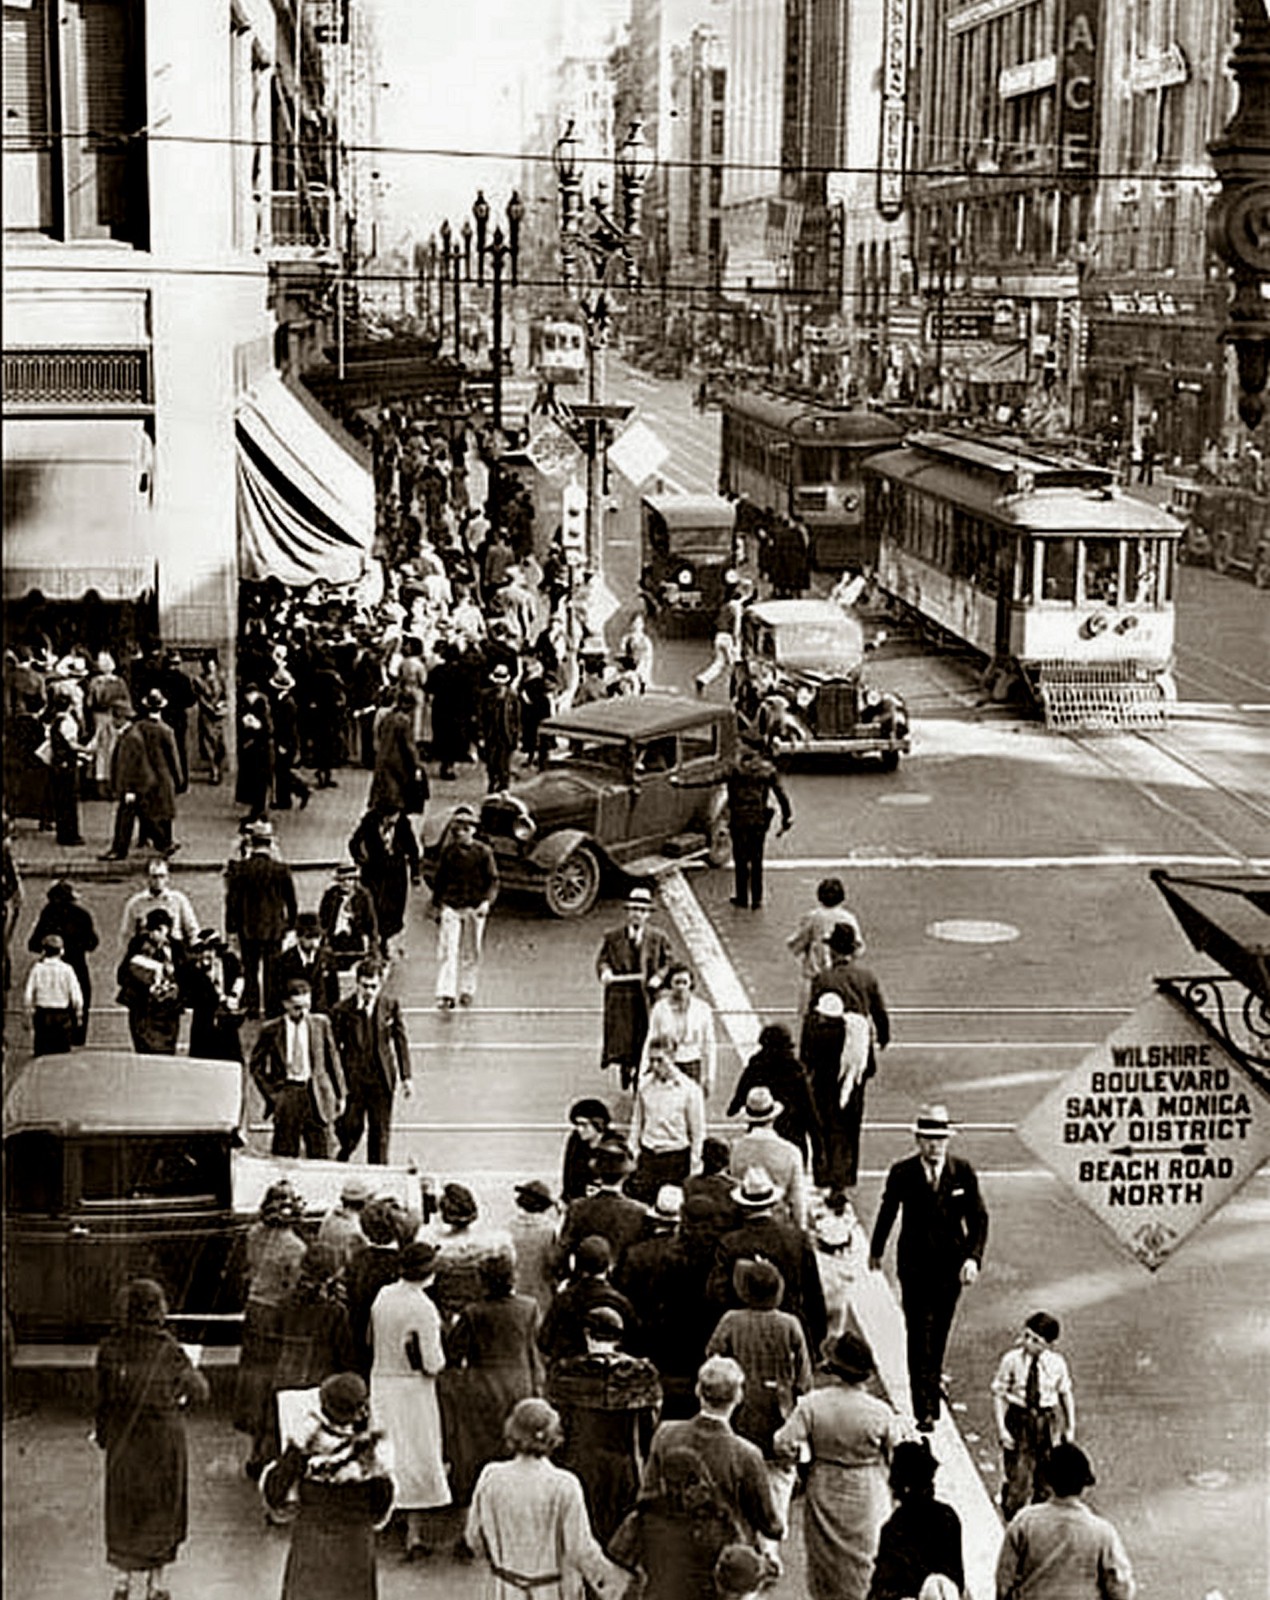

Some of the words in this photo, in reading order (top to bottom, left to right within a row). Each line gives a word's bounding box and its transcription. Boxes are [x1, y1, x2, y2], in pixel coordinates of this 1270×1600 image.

[1112, 1046, 1211, 1067] WILSHIRE
[1092, 1070, 1229, 1093] BOULEVARD
[1066, 1098, 1144, 1118] SANTA
[1158, 1094, 1251, 1117] MONICA
[1065, 1123, 1115, 1143] BAY
[1130, 1119, 1251, 1142] DISTRICT
[1080, 1161, 1159, 1182] BEACH
[1169, 1159, 1232, 1180] ROAD
[1109, 1184, 1203, 1206] NORTH
